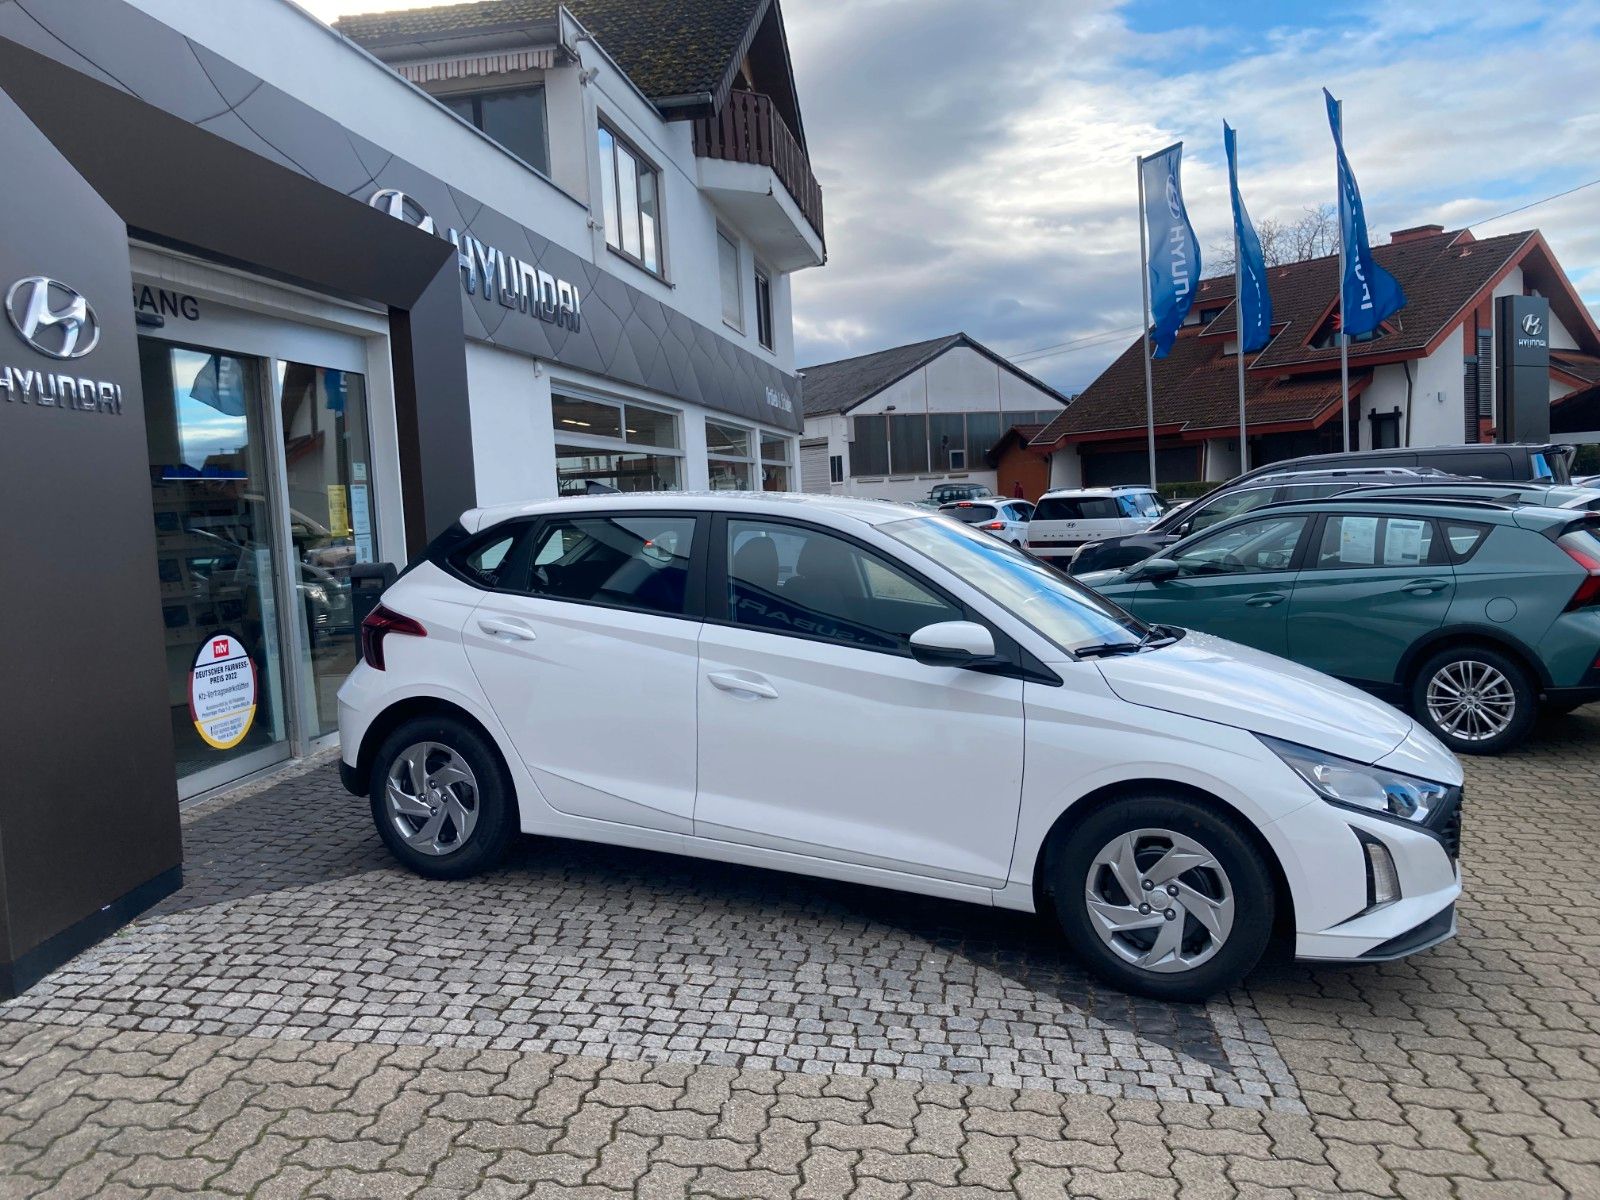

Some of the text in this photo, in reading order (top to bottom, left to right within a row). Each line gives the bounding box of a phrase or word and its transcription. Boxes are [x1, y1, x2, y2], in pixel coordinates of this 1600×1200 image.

[448, 228, 581, 334] HYUNDAI
[214, 642, 228, 655] ntv
[195, 666, 225, 680] DEUTSCHER
[210, 672, 238, 685] PREIS 2022
